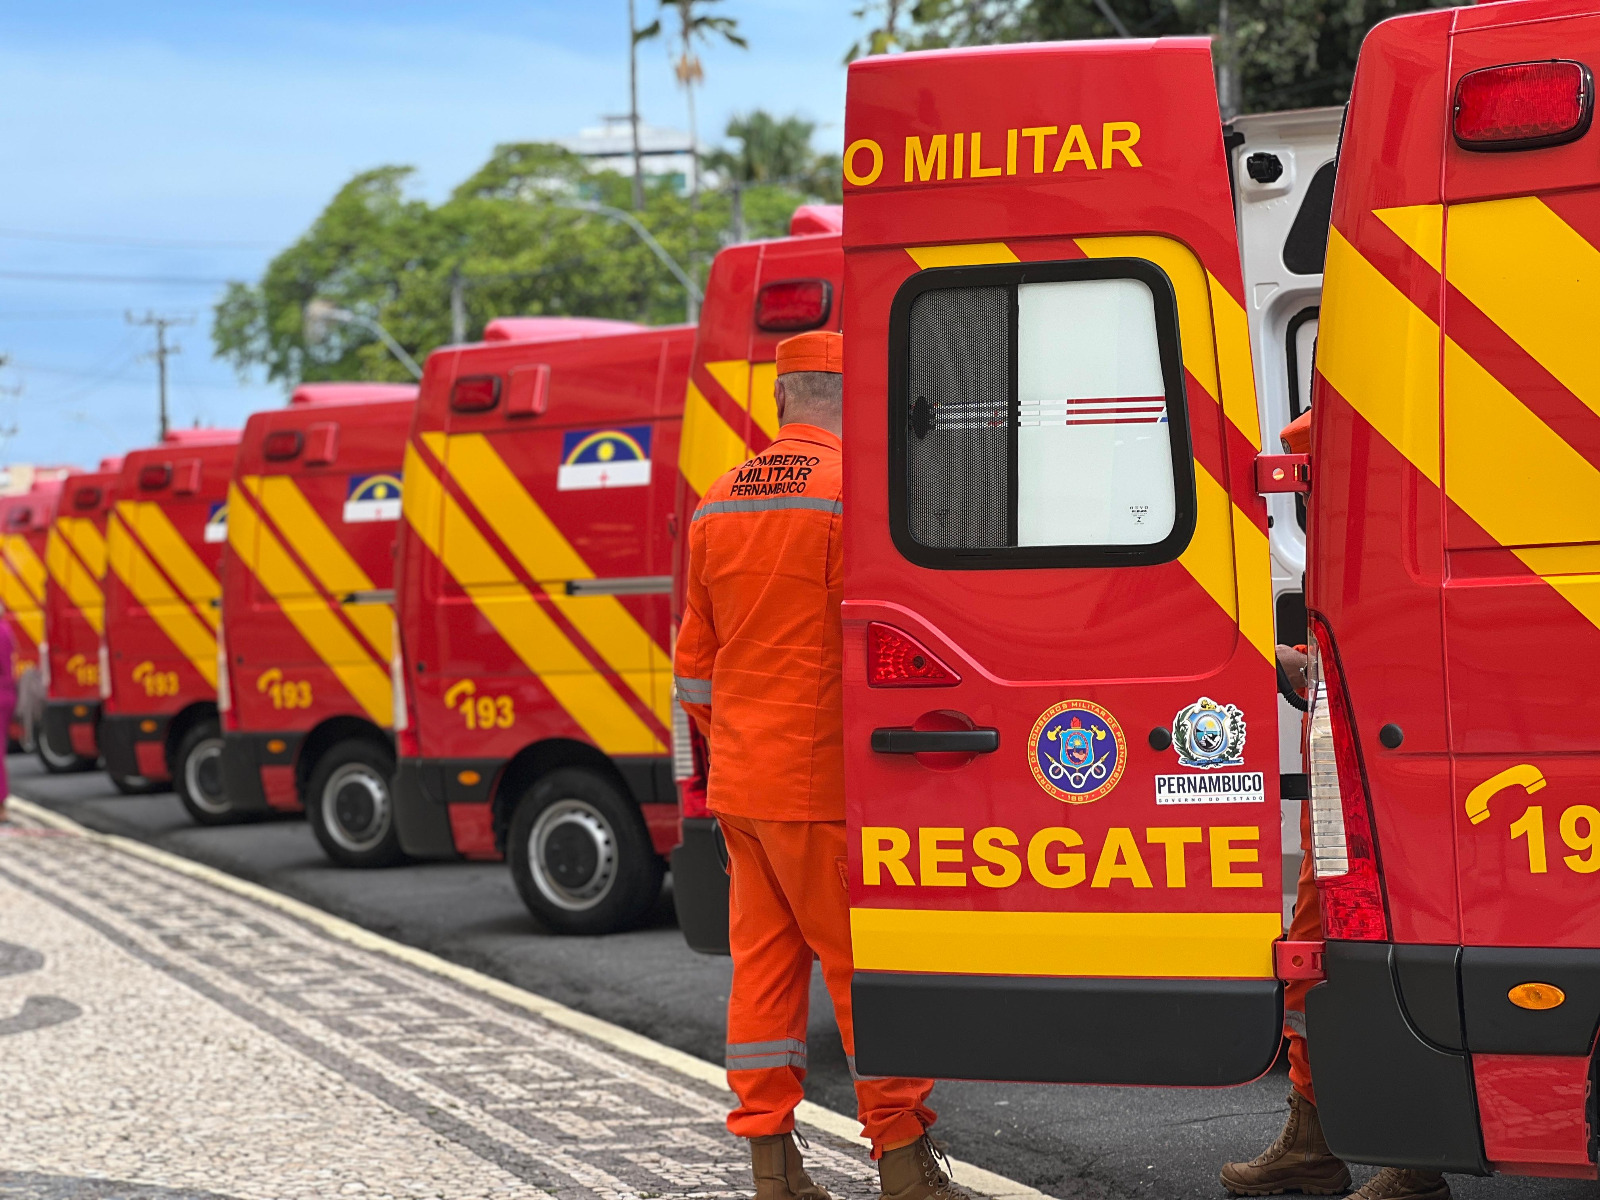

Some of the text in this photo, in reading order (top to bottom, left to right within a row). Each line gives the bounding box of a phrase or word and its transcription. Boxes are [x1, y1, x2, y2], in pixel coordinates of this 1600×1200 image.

[843, 121, 1143, 186] O MILITAR
[741, 454, 820, 469] BOMBEIRO
[730, 481, 806, 497] PERNAMBUCO
[734, 467, 812, 484] MILITAR
[144, 671, 179, 696] 193
[269, 680, 312, 709] 193
[459, 695, 515, 729] 193
[1071, 702, 1106, 717] MILITAR
[1106, 717, 1117, 729] DE
[1030, 703, 1068, 747] BOMBEIROS
[1099, 731, 1125, 794] PERNAMBUCO
[1034, 766, 1057, 795] CORPO
[1157, 774, 1262, 794] PERNAMBUCO
[861, 825, 1263, 889] RESGATE
